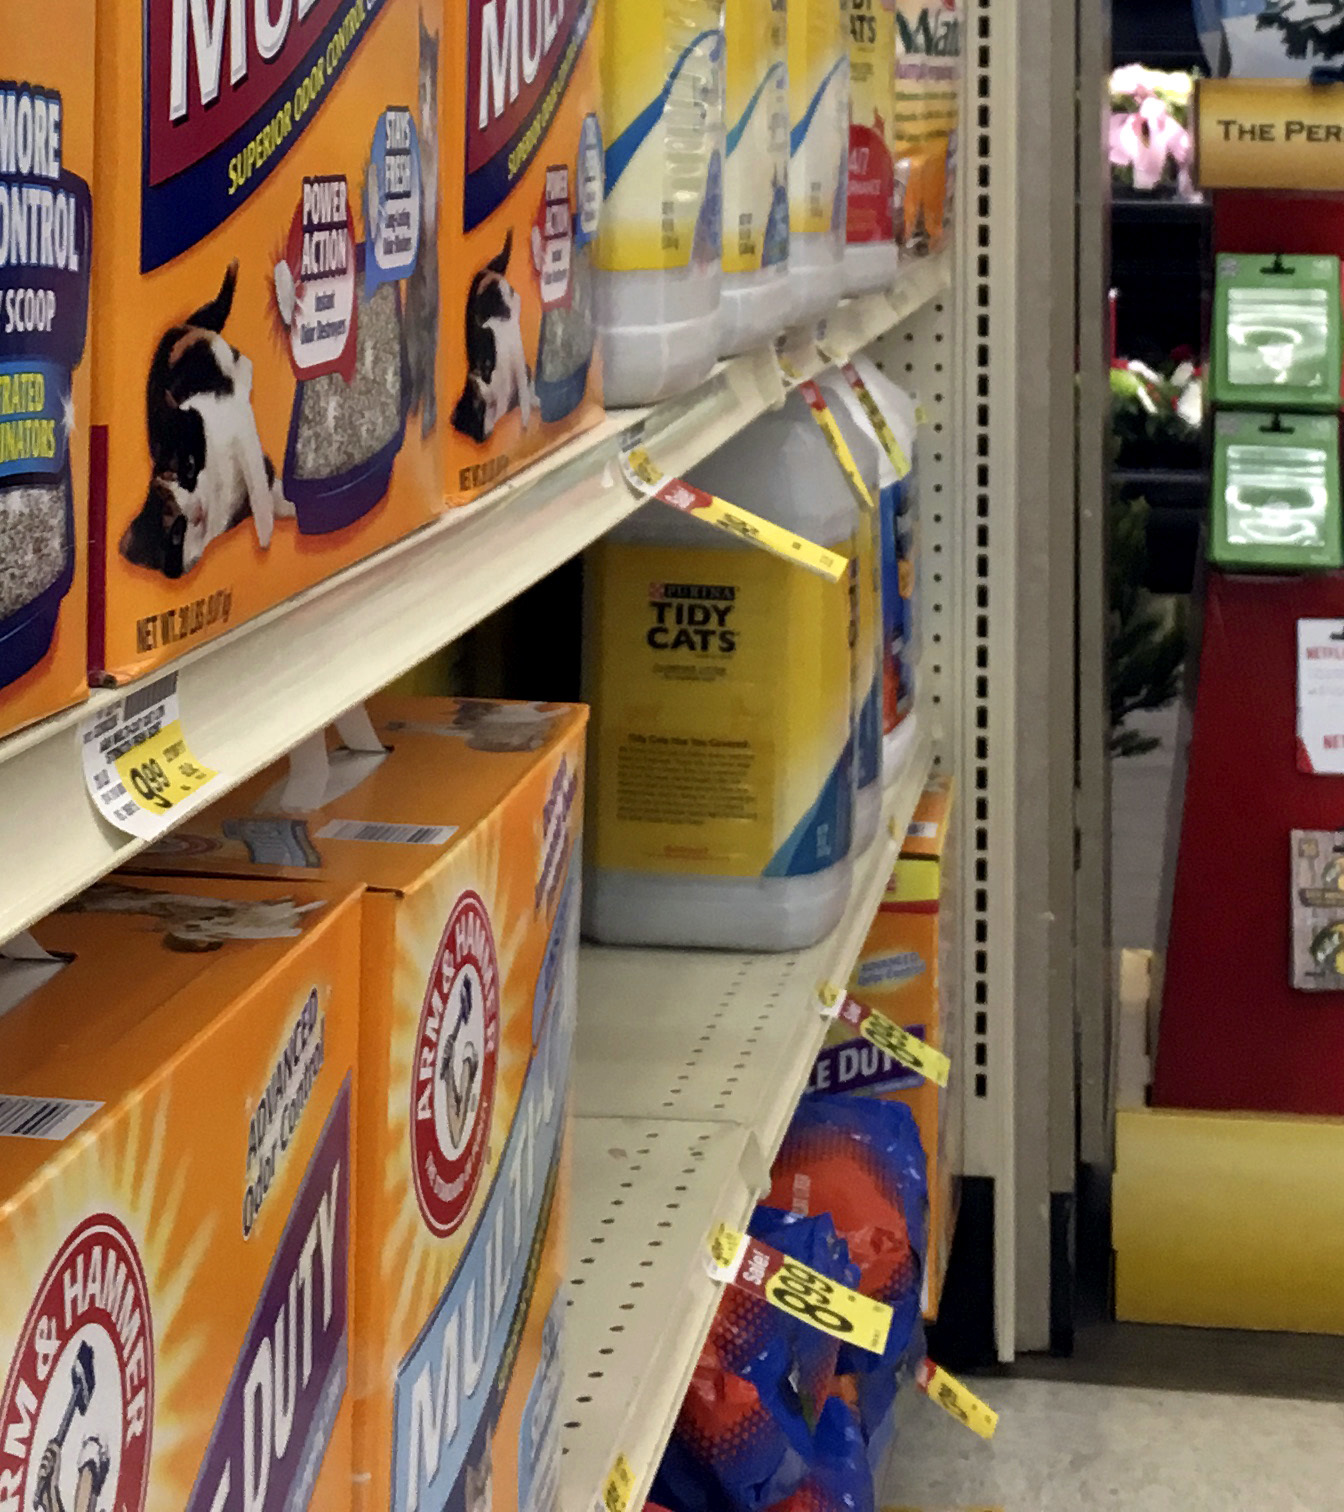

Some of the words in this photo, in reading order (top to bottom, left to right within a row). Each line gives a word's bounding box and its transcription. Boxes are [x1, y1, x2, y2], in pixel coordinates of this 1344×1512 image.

[228, 100, 293, 196] SUPERIOR
[1217, 118, 1276, 143] THE
[303, 180, 347, 226] POWER
[301, 228, 348, 276] ACTION
[5, 288, 56, 334] SCOOP
[649, 601, 735, 627] TIDY
[646, 625, 737, 653] CATS
[416, 988, 445, 1121] ARM
[62, 1244, 147, 1451] HAMMER
[242, 1159, 341, 1512] DUTY
